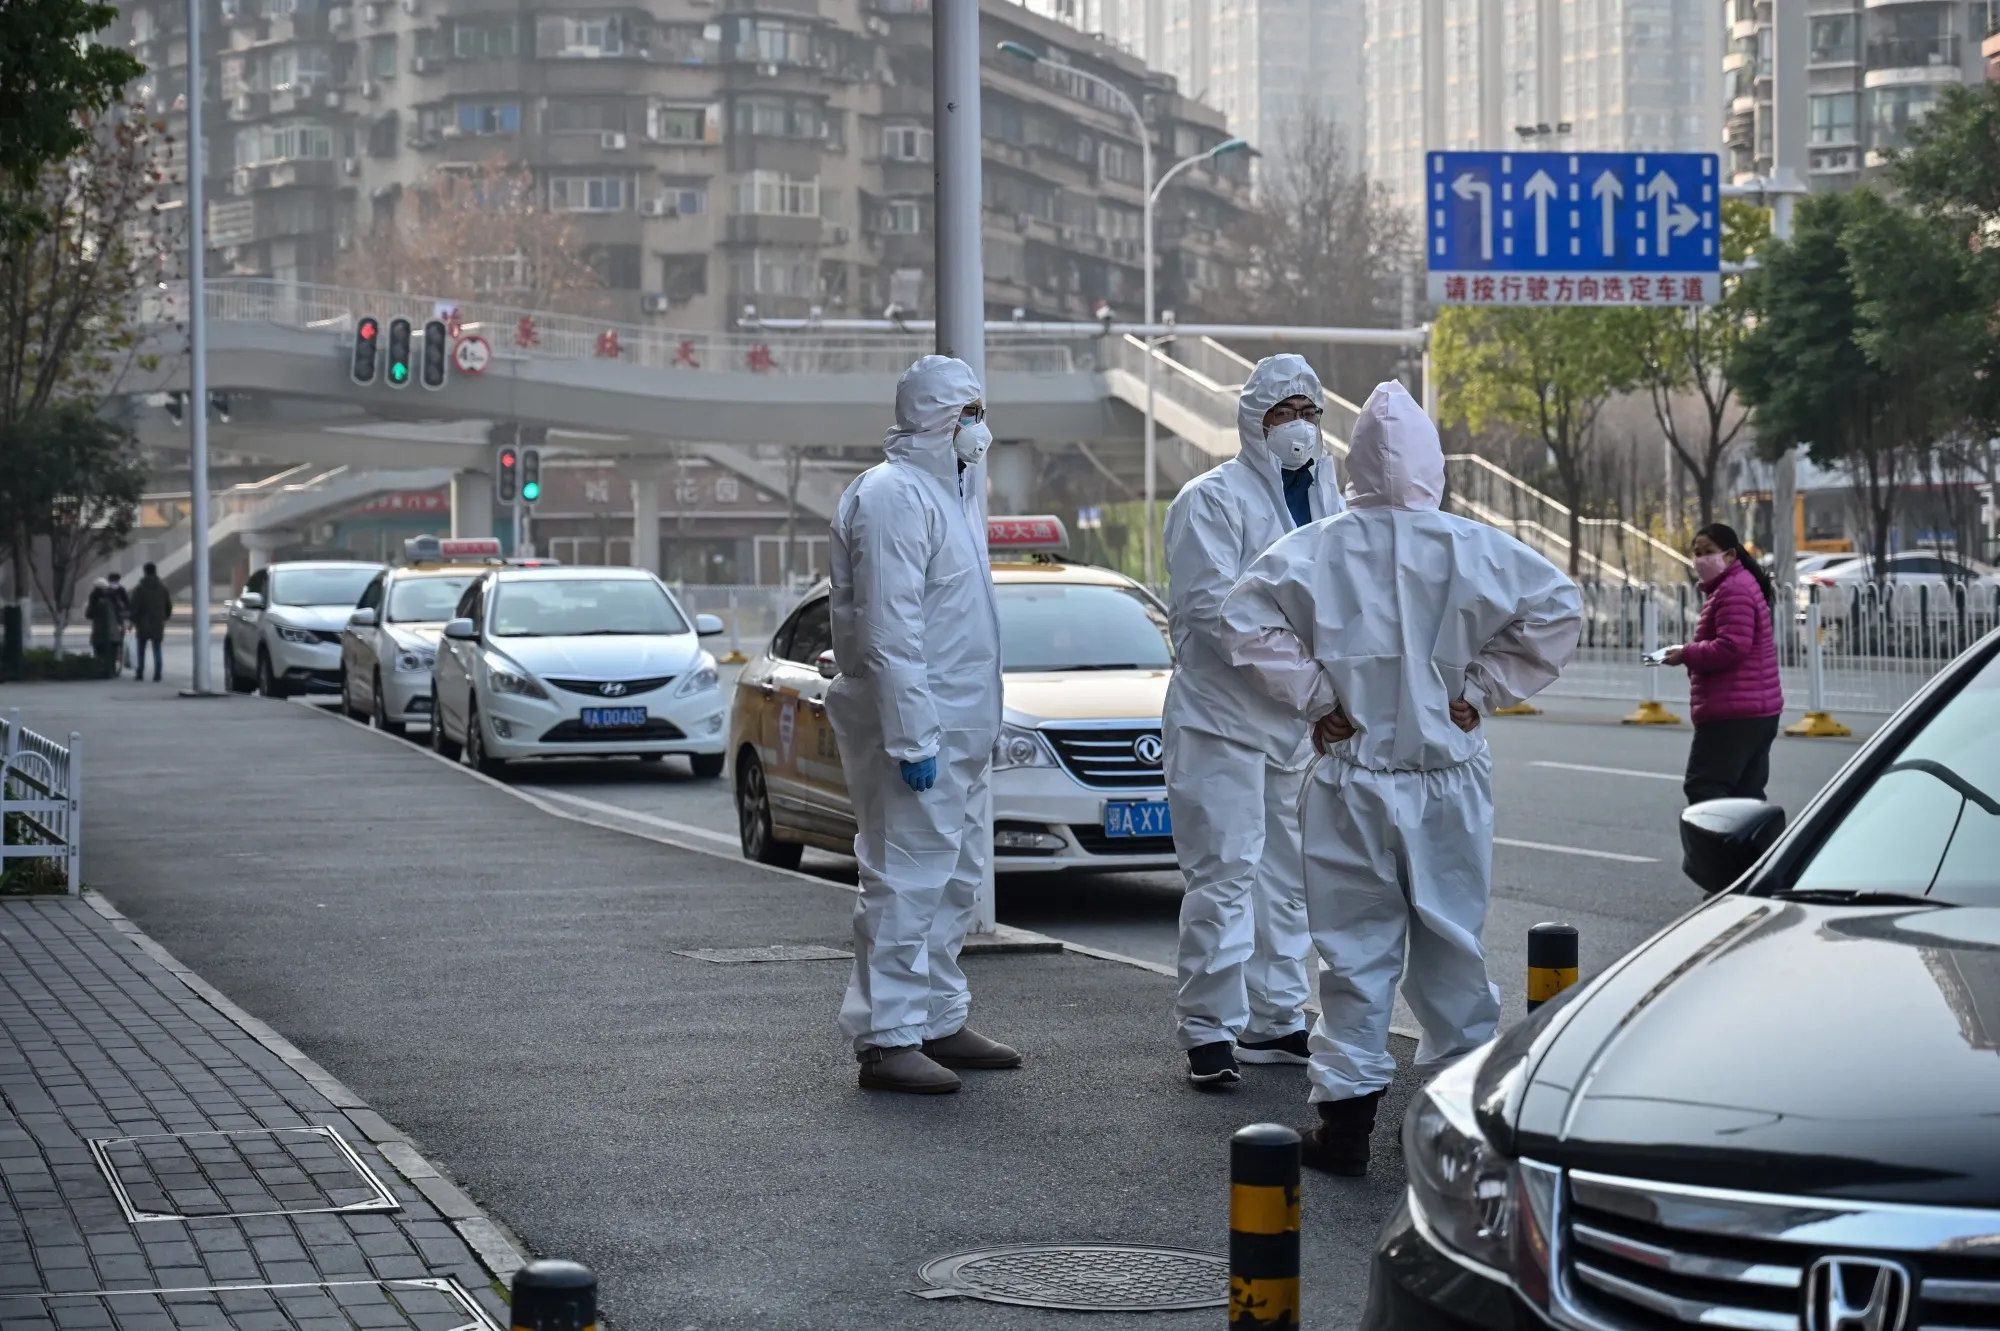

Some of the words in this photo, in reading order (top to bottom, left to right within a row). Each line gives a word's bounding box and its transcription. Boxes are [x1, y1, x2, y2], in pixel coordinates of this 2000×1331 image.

[1444, 275, 1704, 302] 请按行驶方向选定车道
